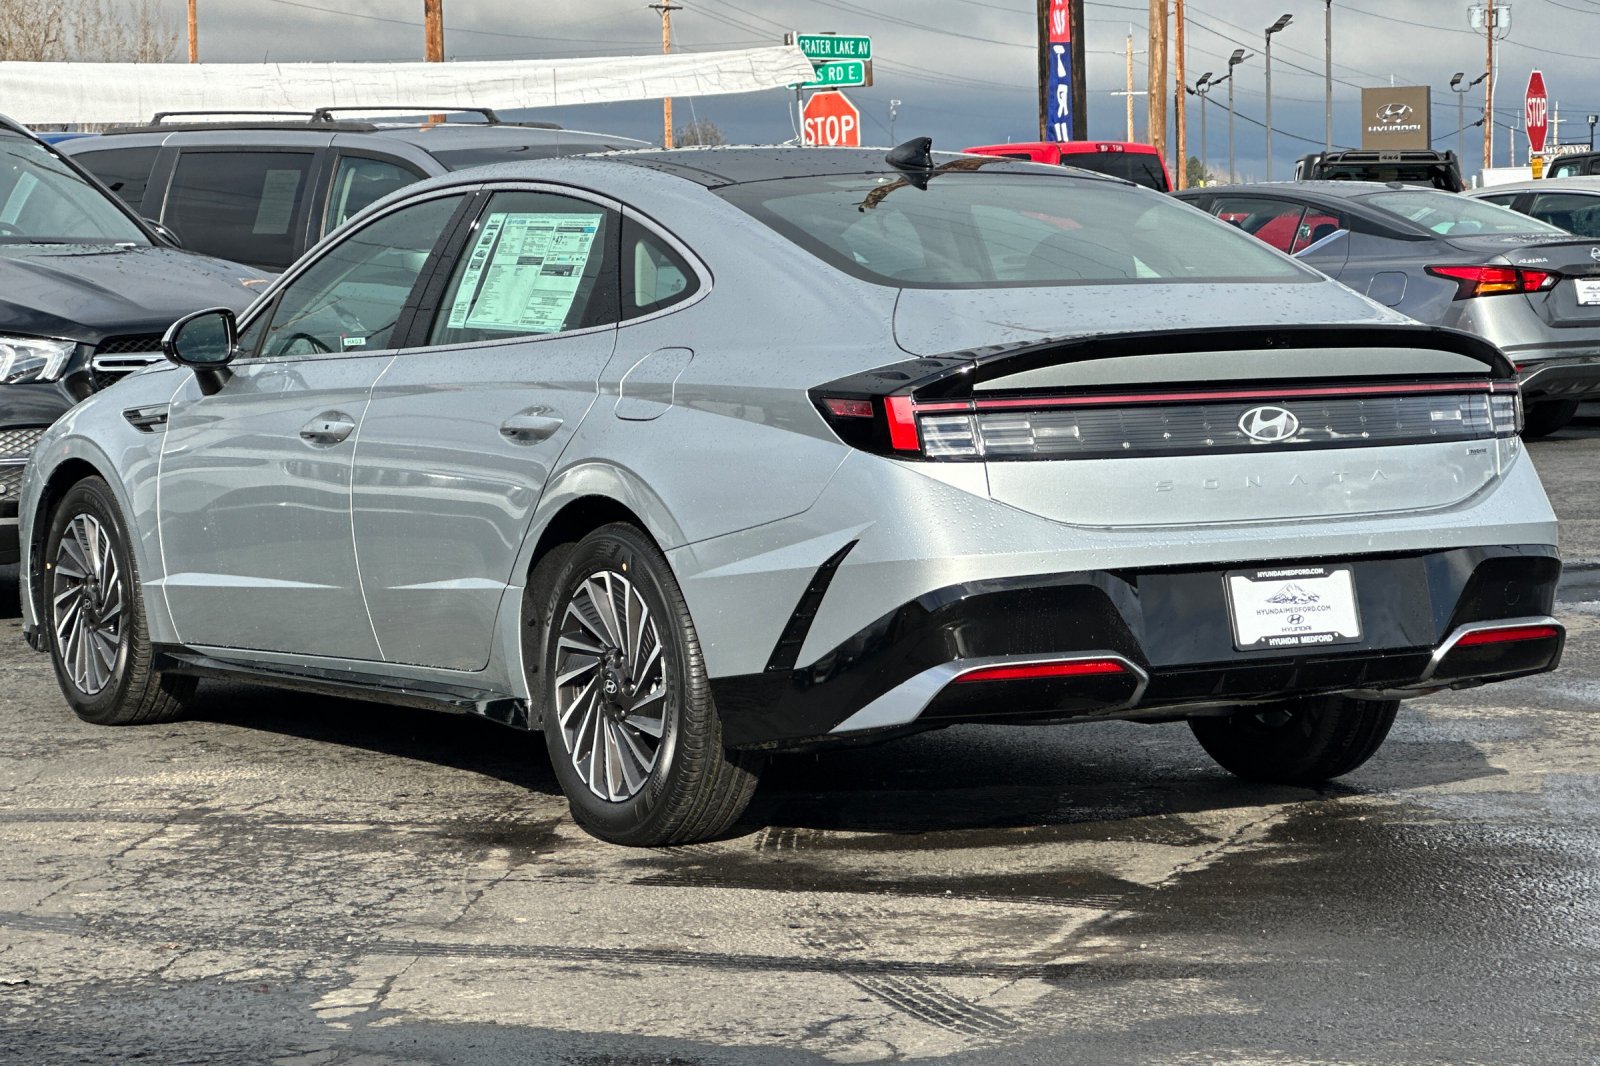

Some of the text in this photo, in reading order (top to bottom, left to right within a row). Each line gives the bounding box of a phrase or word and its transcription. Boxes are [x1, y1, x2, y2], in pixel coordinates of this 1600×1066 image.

[800, 39, 869, 55] CRATER LAKE AV
[828, 67, 843, 81] RD
[848, 65, 859, 80] E.
[1527, 97, 1546, 127] STOP
[805, 115, 854, 146] STOP
[1156, 469, 1388, 493] SONATA
[1257, 568, 1324, 578] HYUNDAIMEDFORD.COM
[1256, 605, 1331, 615] HYUNDAIMEDFORD.COM
[1269, 634, 1333, 646] HYUNDAI MEDFORD
